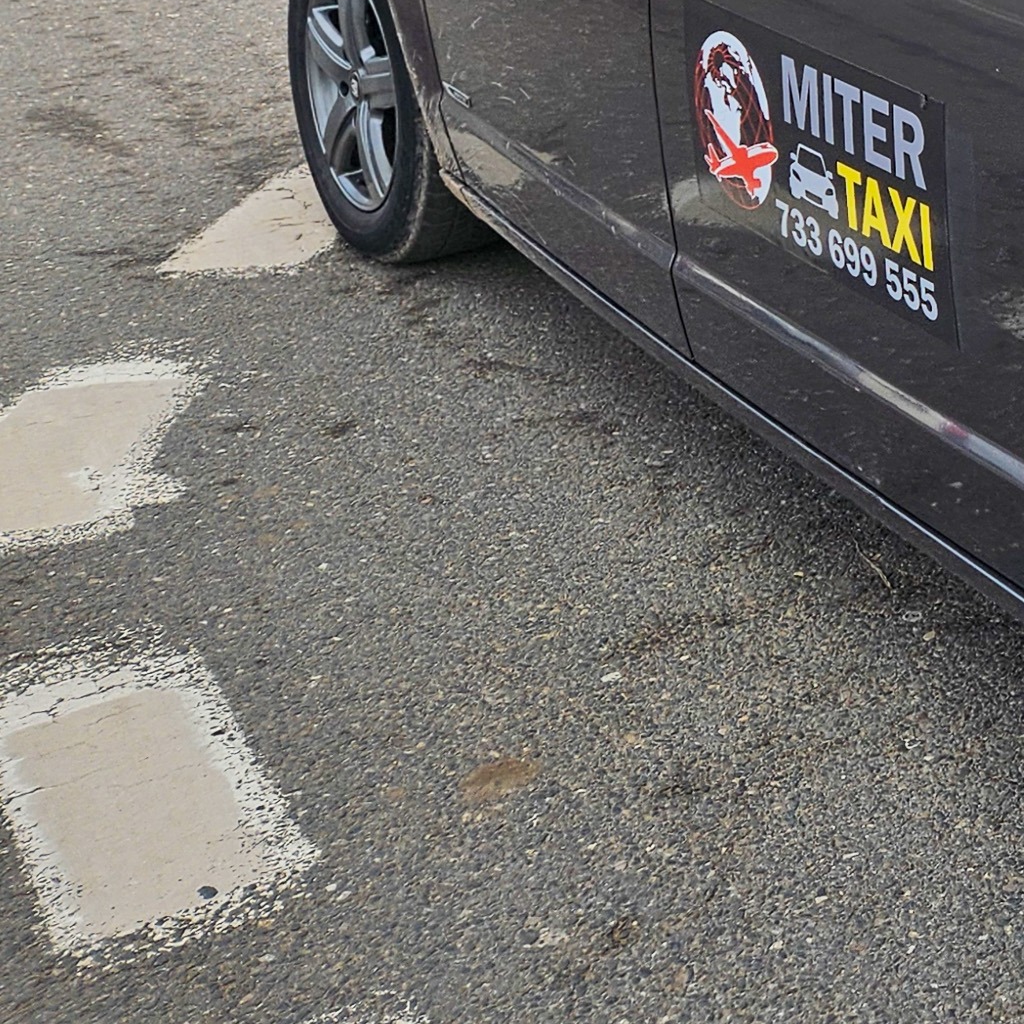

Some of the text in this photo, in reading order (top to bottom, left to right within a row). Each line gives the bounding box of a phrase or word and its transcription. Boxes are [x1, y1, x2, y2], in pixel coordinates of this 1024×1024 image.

[781, 54, 926, 190] MITER
[775, 198, 938, 321] 733 699 555
[836, 161, 934, 272] TAXI
